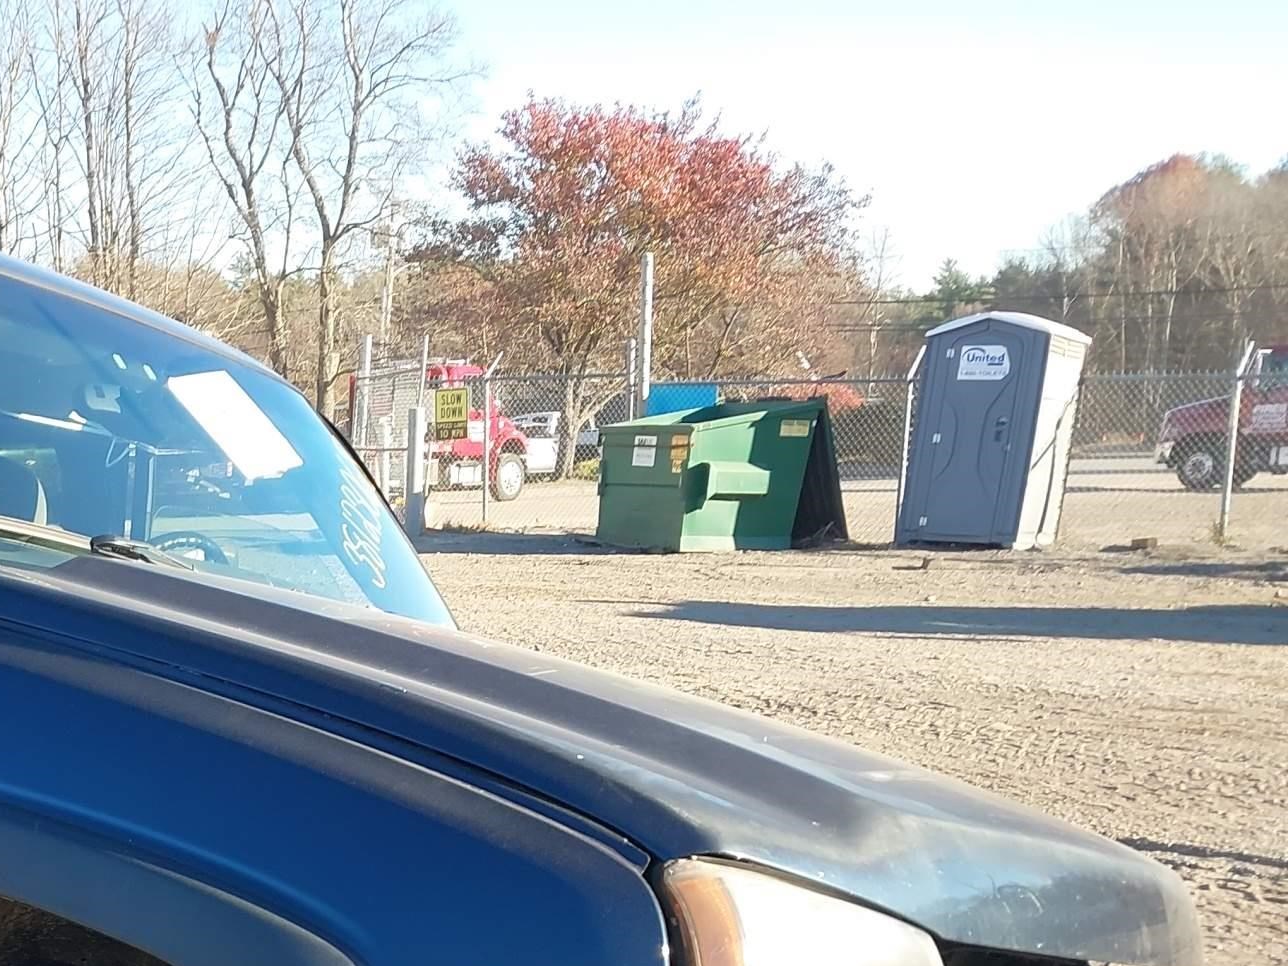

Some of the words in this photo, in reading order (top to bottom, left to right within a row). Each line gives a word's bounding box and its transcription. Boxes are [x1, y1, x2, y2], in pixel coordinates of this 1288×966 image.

[967, 352, 1005, 362] United
[441, 393, 462, 405] SLOW
[441, 407, 463, 419] DOWN
[440, 430, 449, 439] 10
